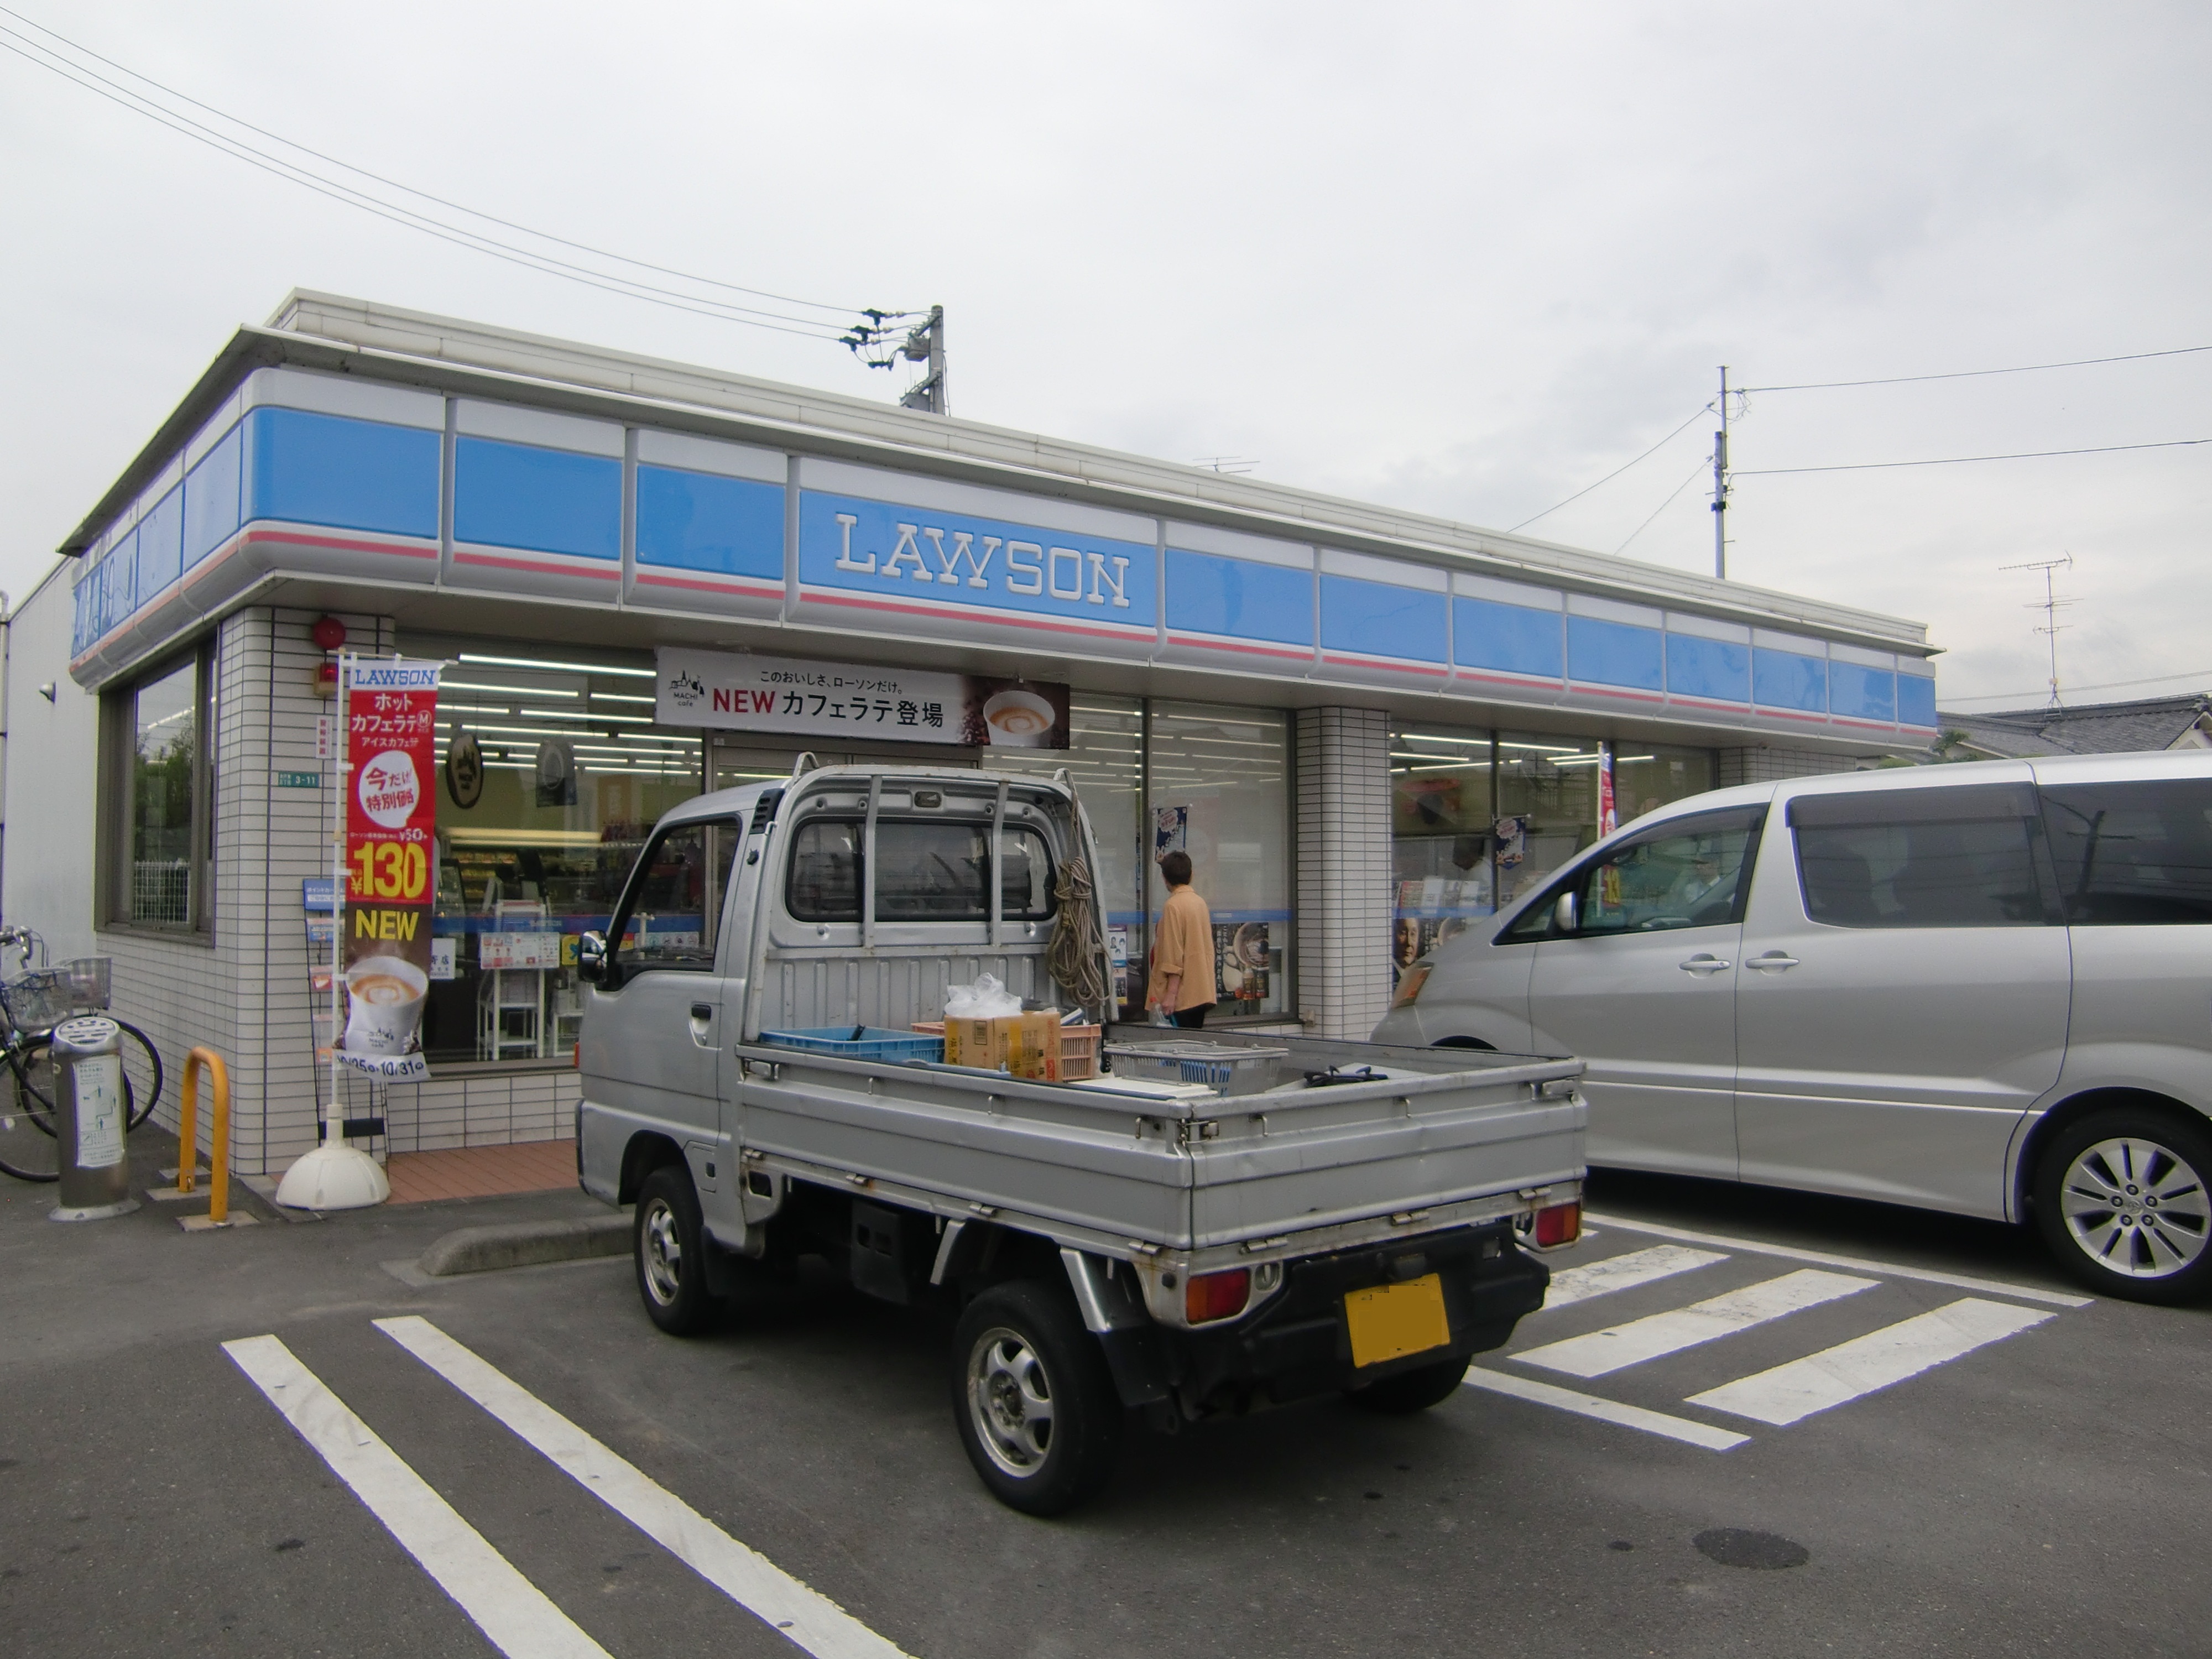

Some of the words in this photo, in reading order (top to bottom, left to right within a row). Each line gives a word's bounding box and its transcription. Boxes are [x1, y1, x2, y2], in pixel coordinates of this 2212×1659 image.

[835, 513, 1130, 607] LAWSON
[355, 669, 436, 685] LAWSON
[760, 671, 902, 694] このおいしさ、ローソンだけ。
[375, 693, 413, 711] ホット
[713, 688, 775, 713] NEW
[782, 691, 943, 728] カフェラテ登場
[295, 776, 315, 784] 3-11
[356, 909, 419, 941] NEW
